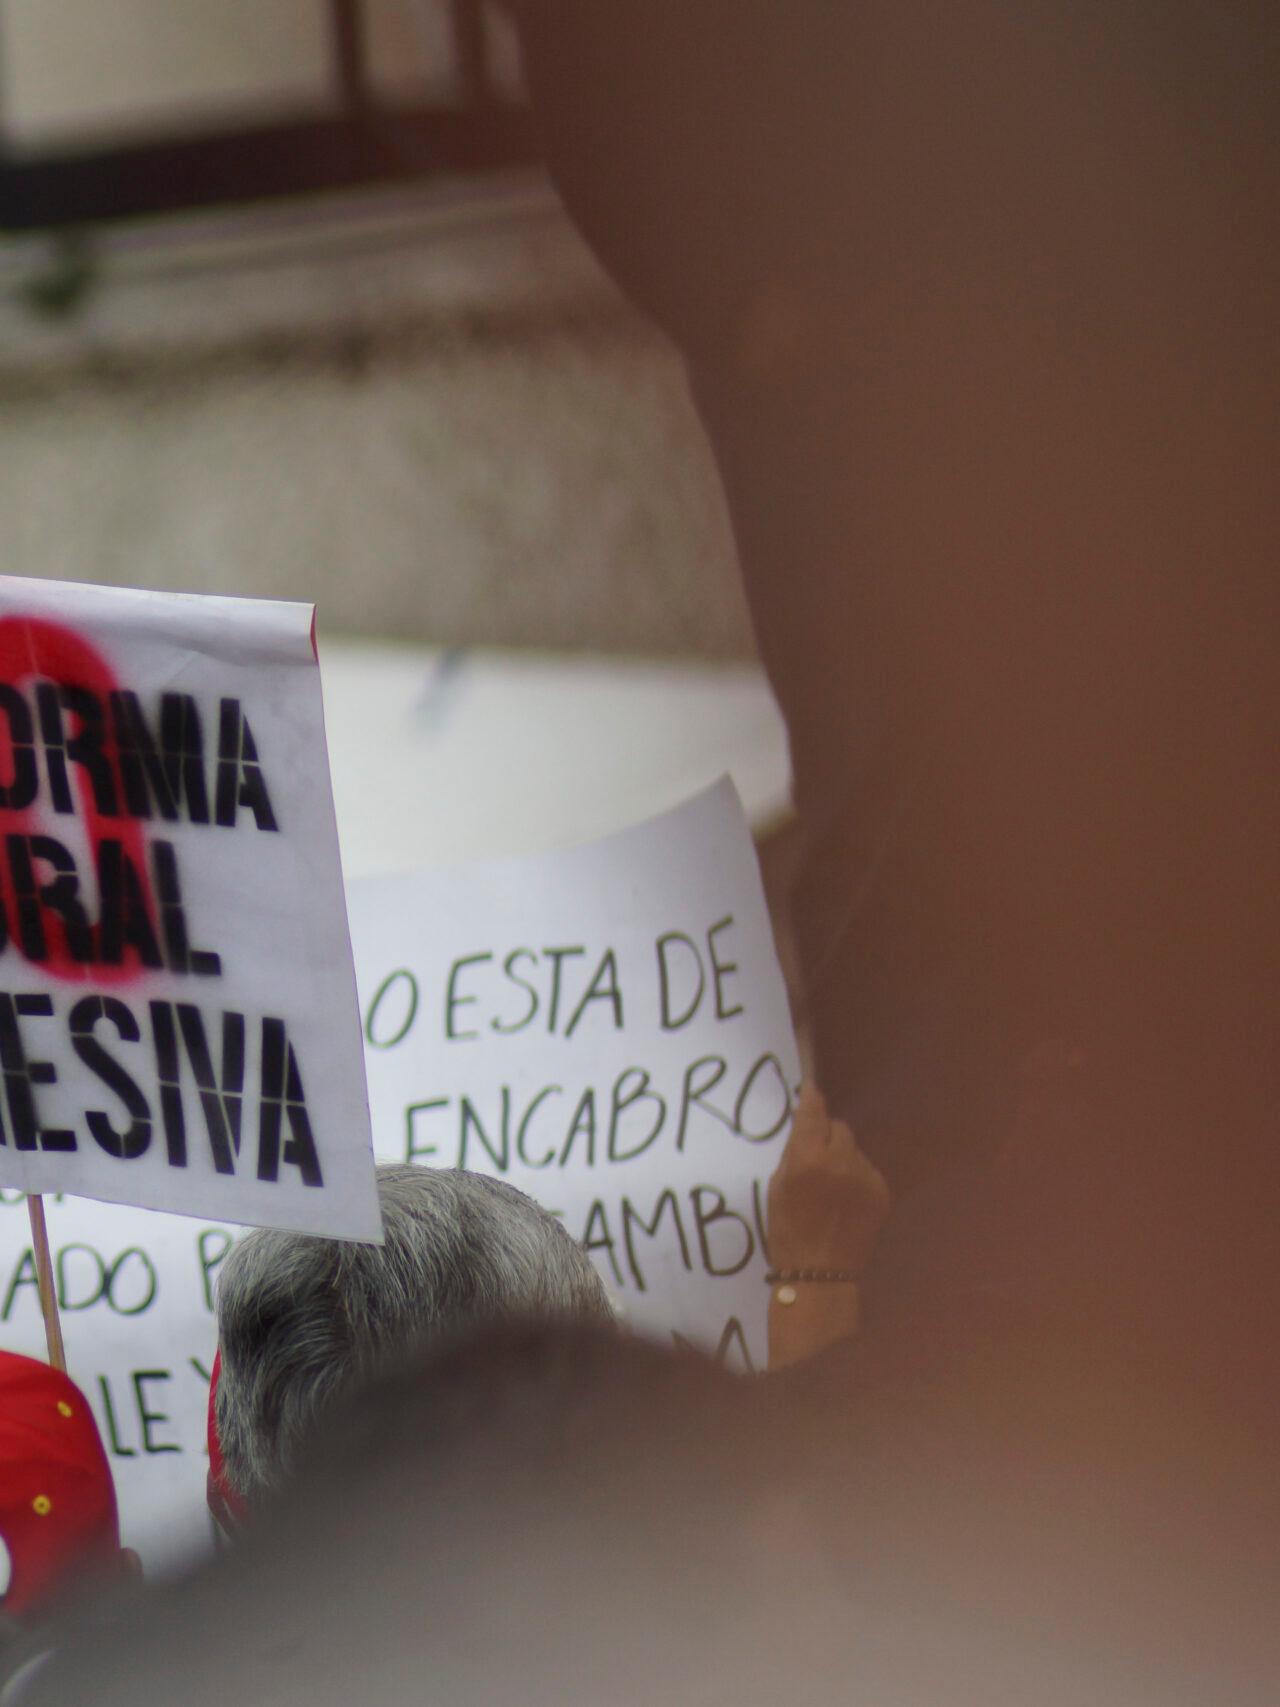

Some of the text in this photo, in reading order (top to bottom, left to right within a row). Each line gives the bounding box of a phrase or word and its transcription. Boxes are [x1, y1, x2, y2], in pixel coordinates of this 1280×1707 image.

[444, 945, 624, 1041] ESTA
[656, 914, 744, 1032] DE
[546, 1181, 772, 1293] AMBI
